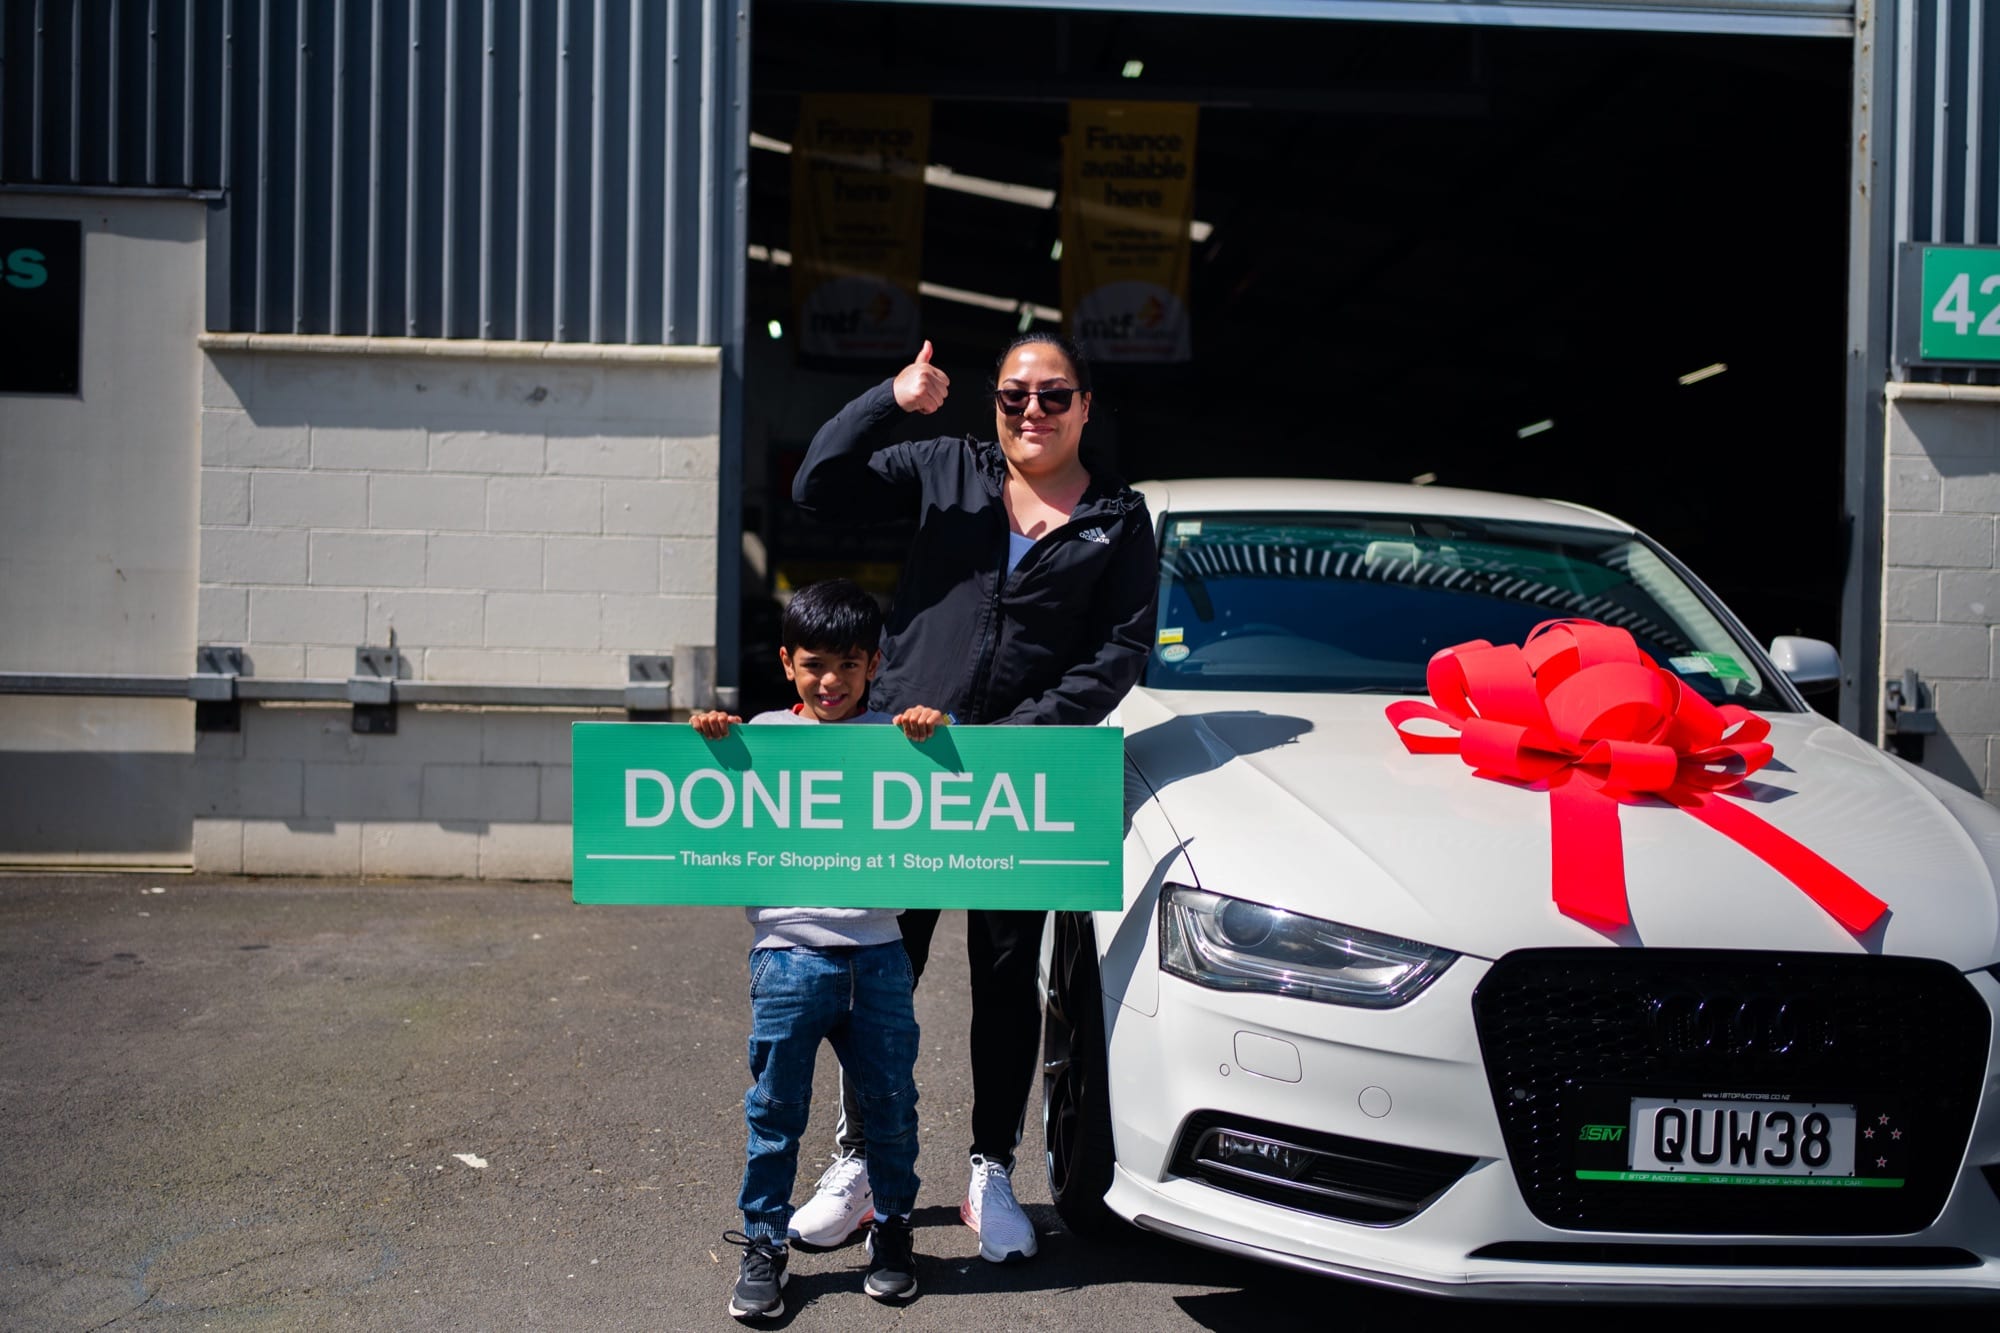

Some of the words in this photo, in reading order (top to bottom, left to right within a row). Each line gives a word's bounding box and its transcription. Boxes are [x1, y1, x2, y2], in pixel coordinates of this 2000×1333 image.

[1086, 125, 1183, 151] Finance
[1081, 153, 1187, 180] available
[1103, 180, 1164, 208] here
[624, 768, 844, 830] DONE
[872, 771, 1075, 833] DEAL
[680, 851, 742, 867] Thanks
[747, 851, 776, 867] For
[779, 851, 862, 872] Shopping
[866, 853, 883, 868] at
[888, 854, 896, 868] 1
[903, 853, 944, 872] Stop
[949, 854, 1014, 870] Motors!
[1653, 1106, 1832, 1168] QUW38
